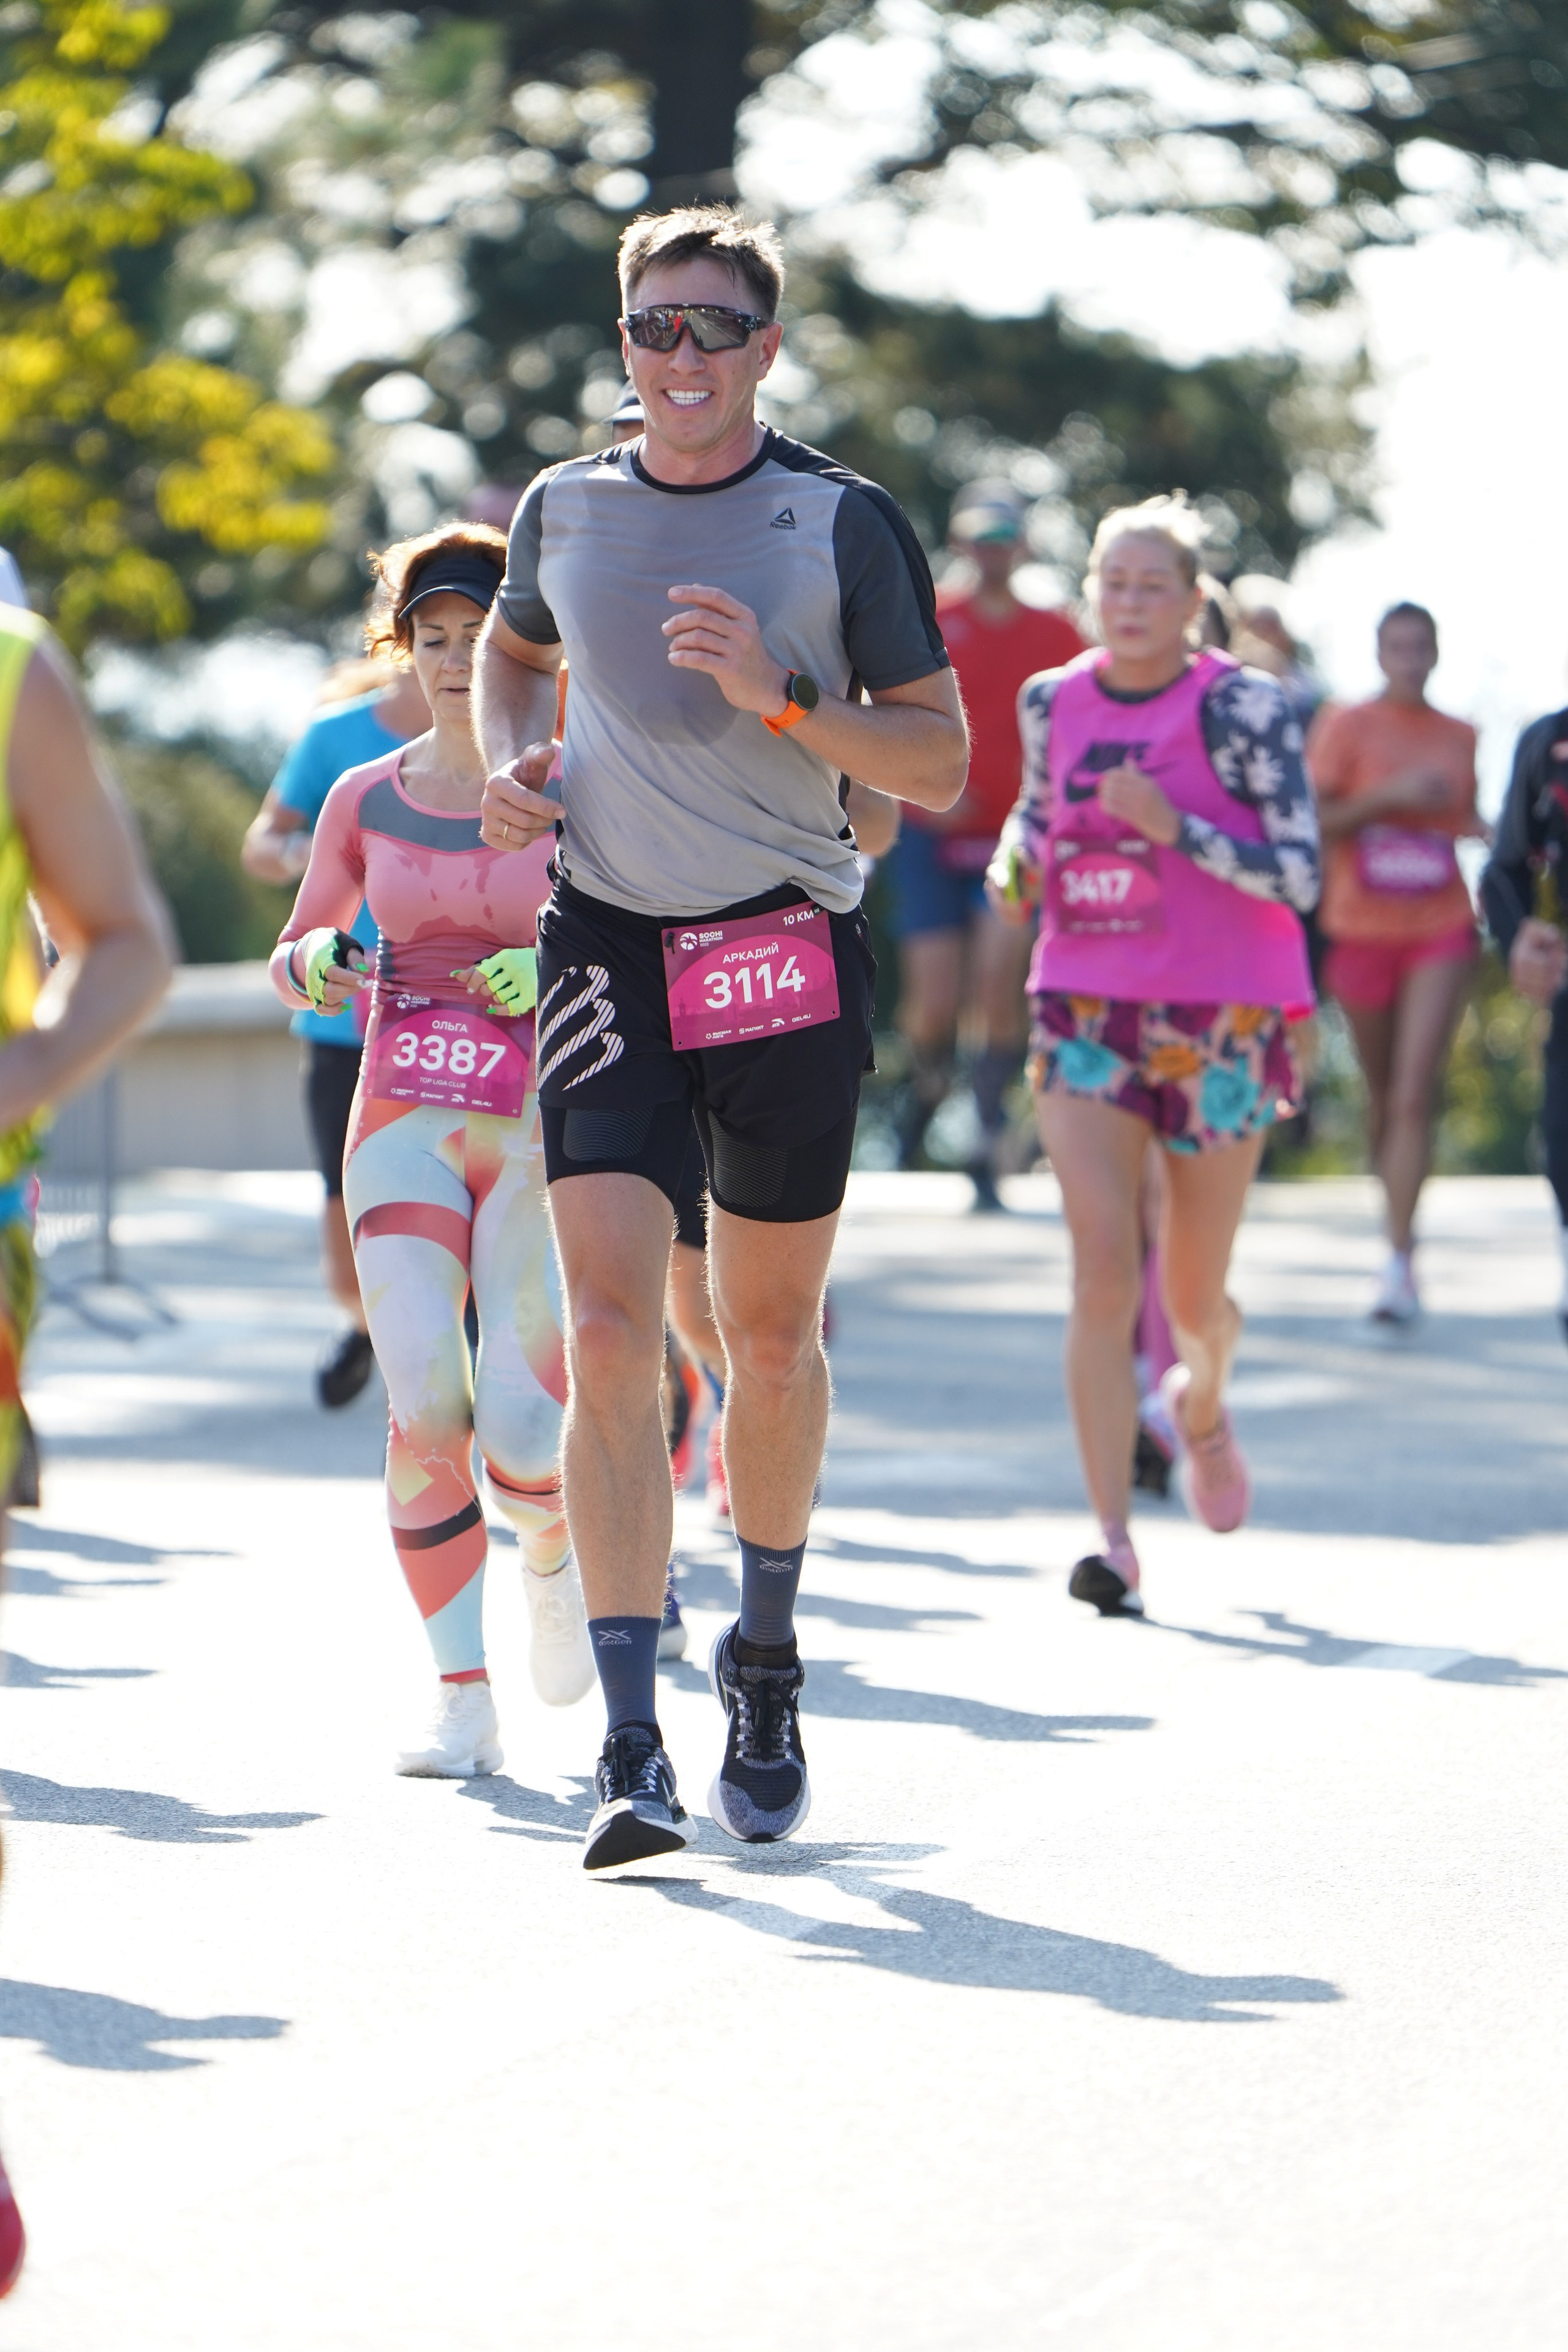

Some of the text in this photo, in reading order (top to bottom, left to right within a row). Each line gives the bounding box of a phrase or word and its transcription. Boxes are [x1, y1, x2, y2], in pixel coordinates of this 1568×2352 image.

[769, 521, 796, 530] Reebok
[1060, 869, 1133, 906] 3417
[783, 909, 814, 926] 10 KM
[699, 930, 723, 939] SOCHI
[722, 941, 779, 963] АРКАДИЙ
[703, 955, 806, 1009] 3114
[432, 1020, 468, 1033] ОЛЬГА
[791, 1014, 811, 1023] GEL4U
[392, 1031, 506, 1078] 3387
